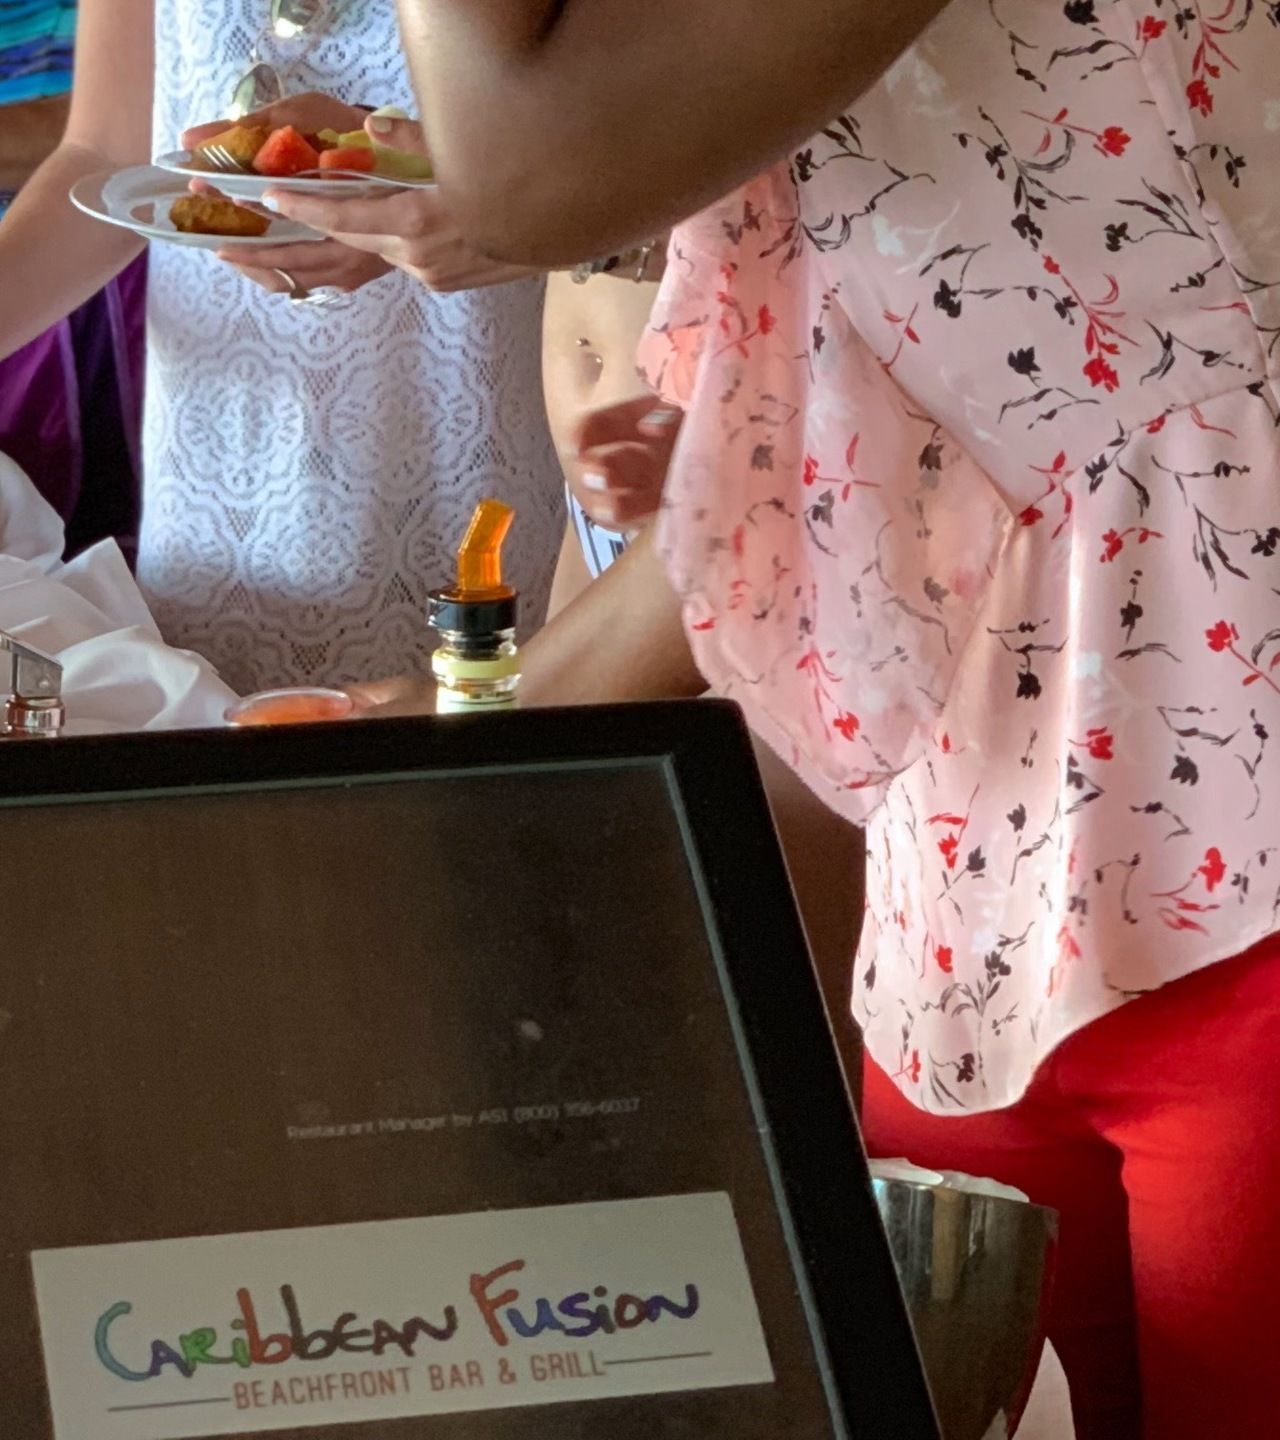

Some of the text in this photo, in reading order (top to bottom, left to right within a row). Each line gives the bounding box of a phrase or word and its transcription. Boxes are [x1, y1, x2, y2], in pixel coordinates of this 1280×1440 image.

[232, 1349, 606, 1410] BEACHFRONT BAR & GRILL
